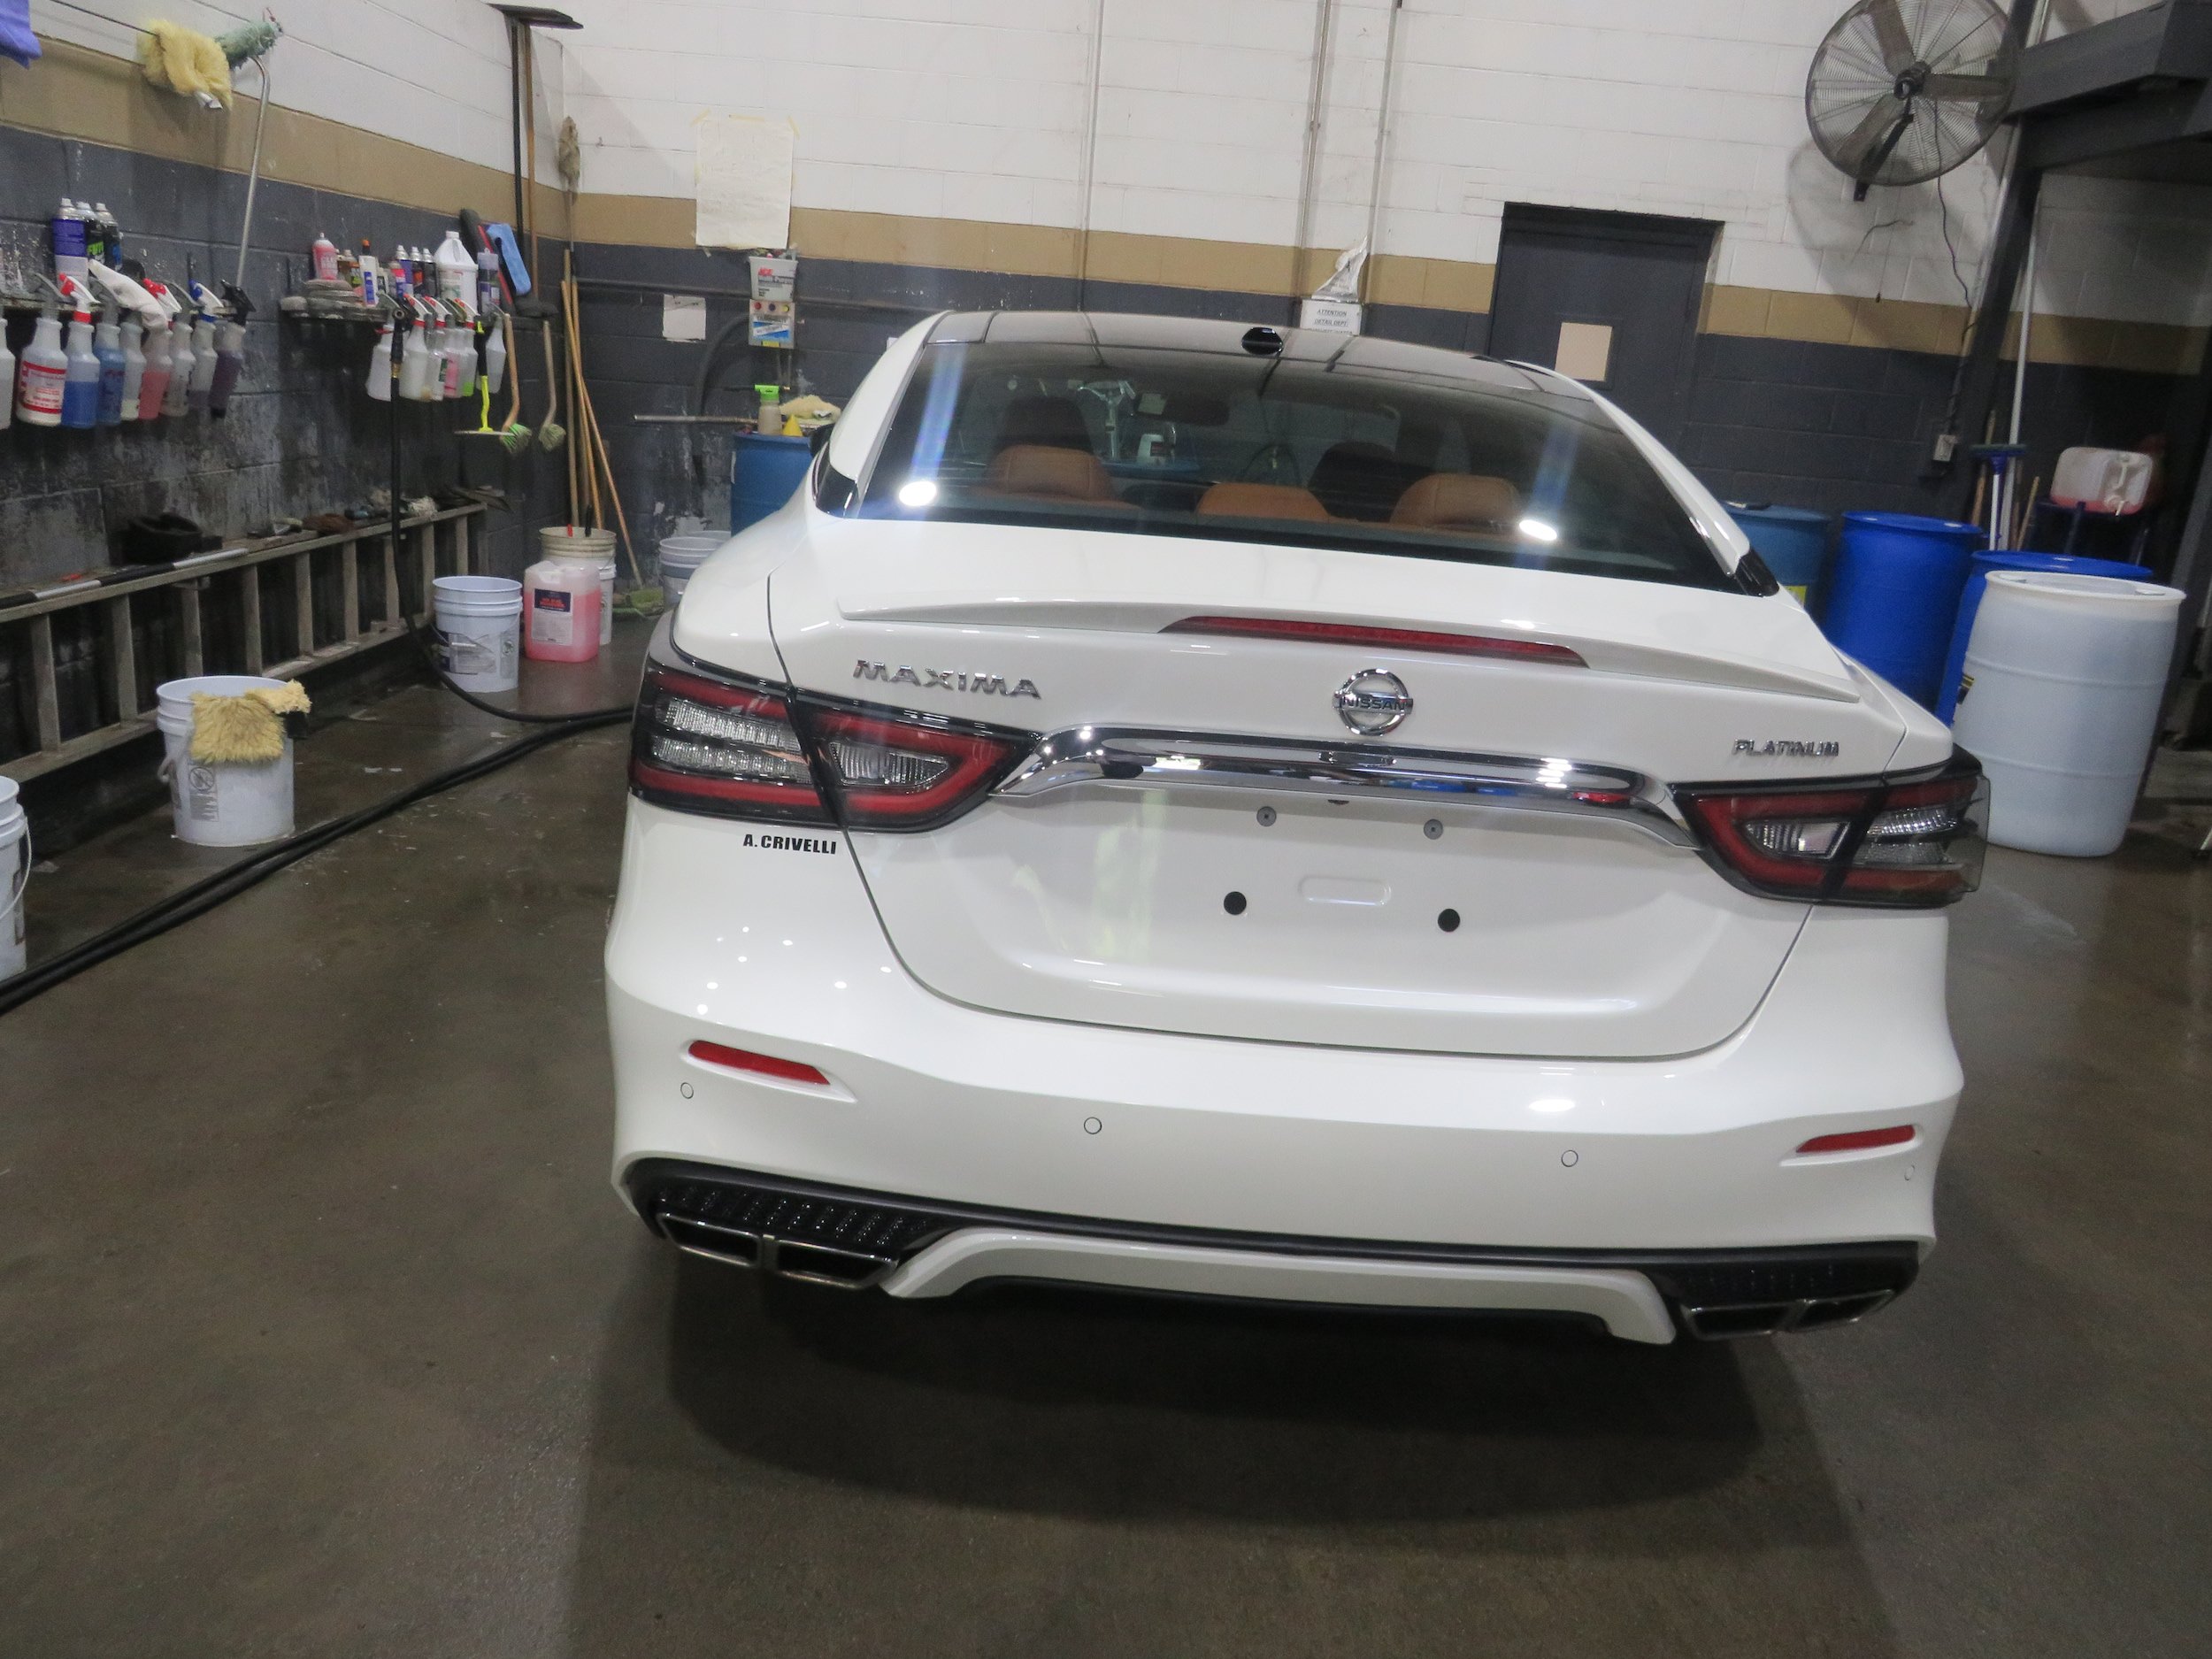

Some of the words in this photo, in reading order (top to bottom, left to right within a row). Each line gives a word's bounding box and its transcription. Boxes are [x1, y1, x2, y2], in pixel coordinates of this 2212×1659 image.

[853, 660, 1041, 700] MAXIMA
[1339, 695, 1405, 710] NISSAN
[1732, 739, 1839, 757] PLATINUM
[761, 835, 836, 855] CRIVELLI
